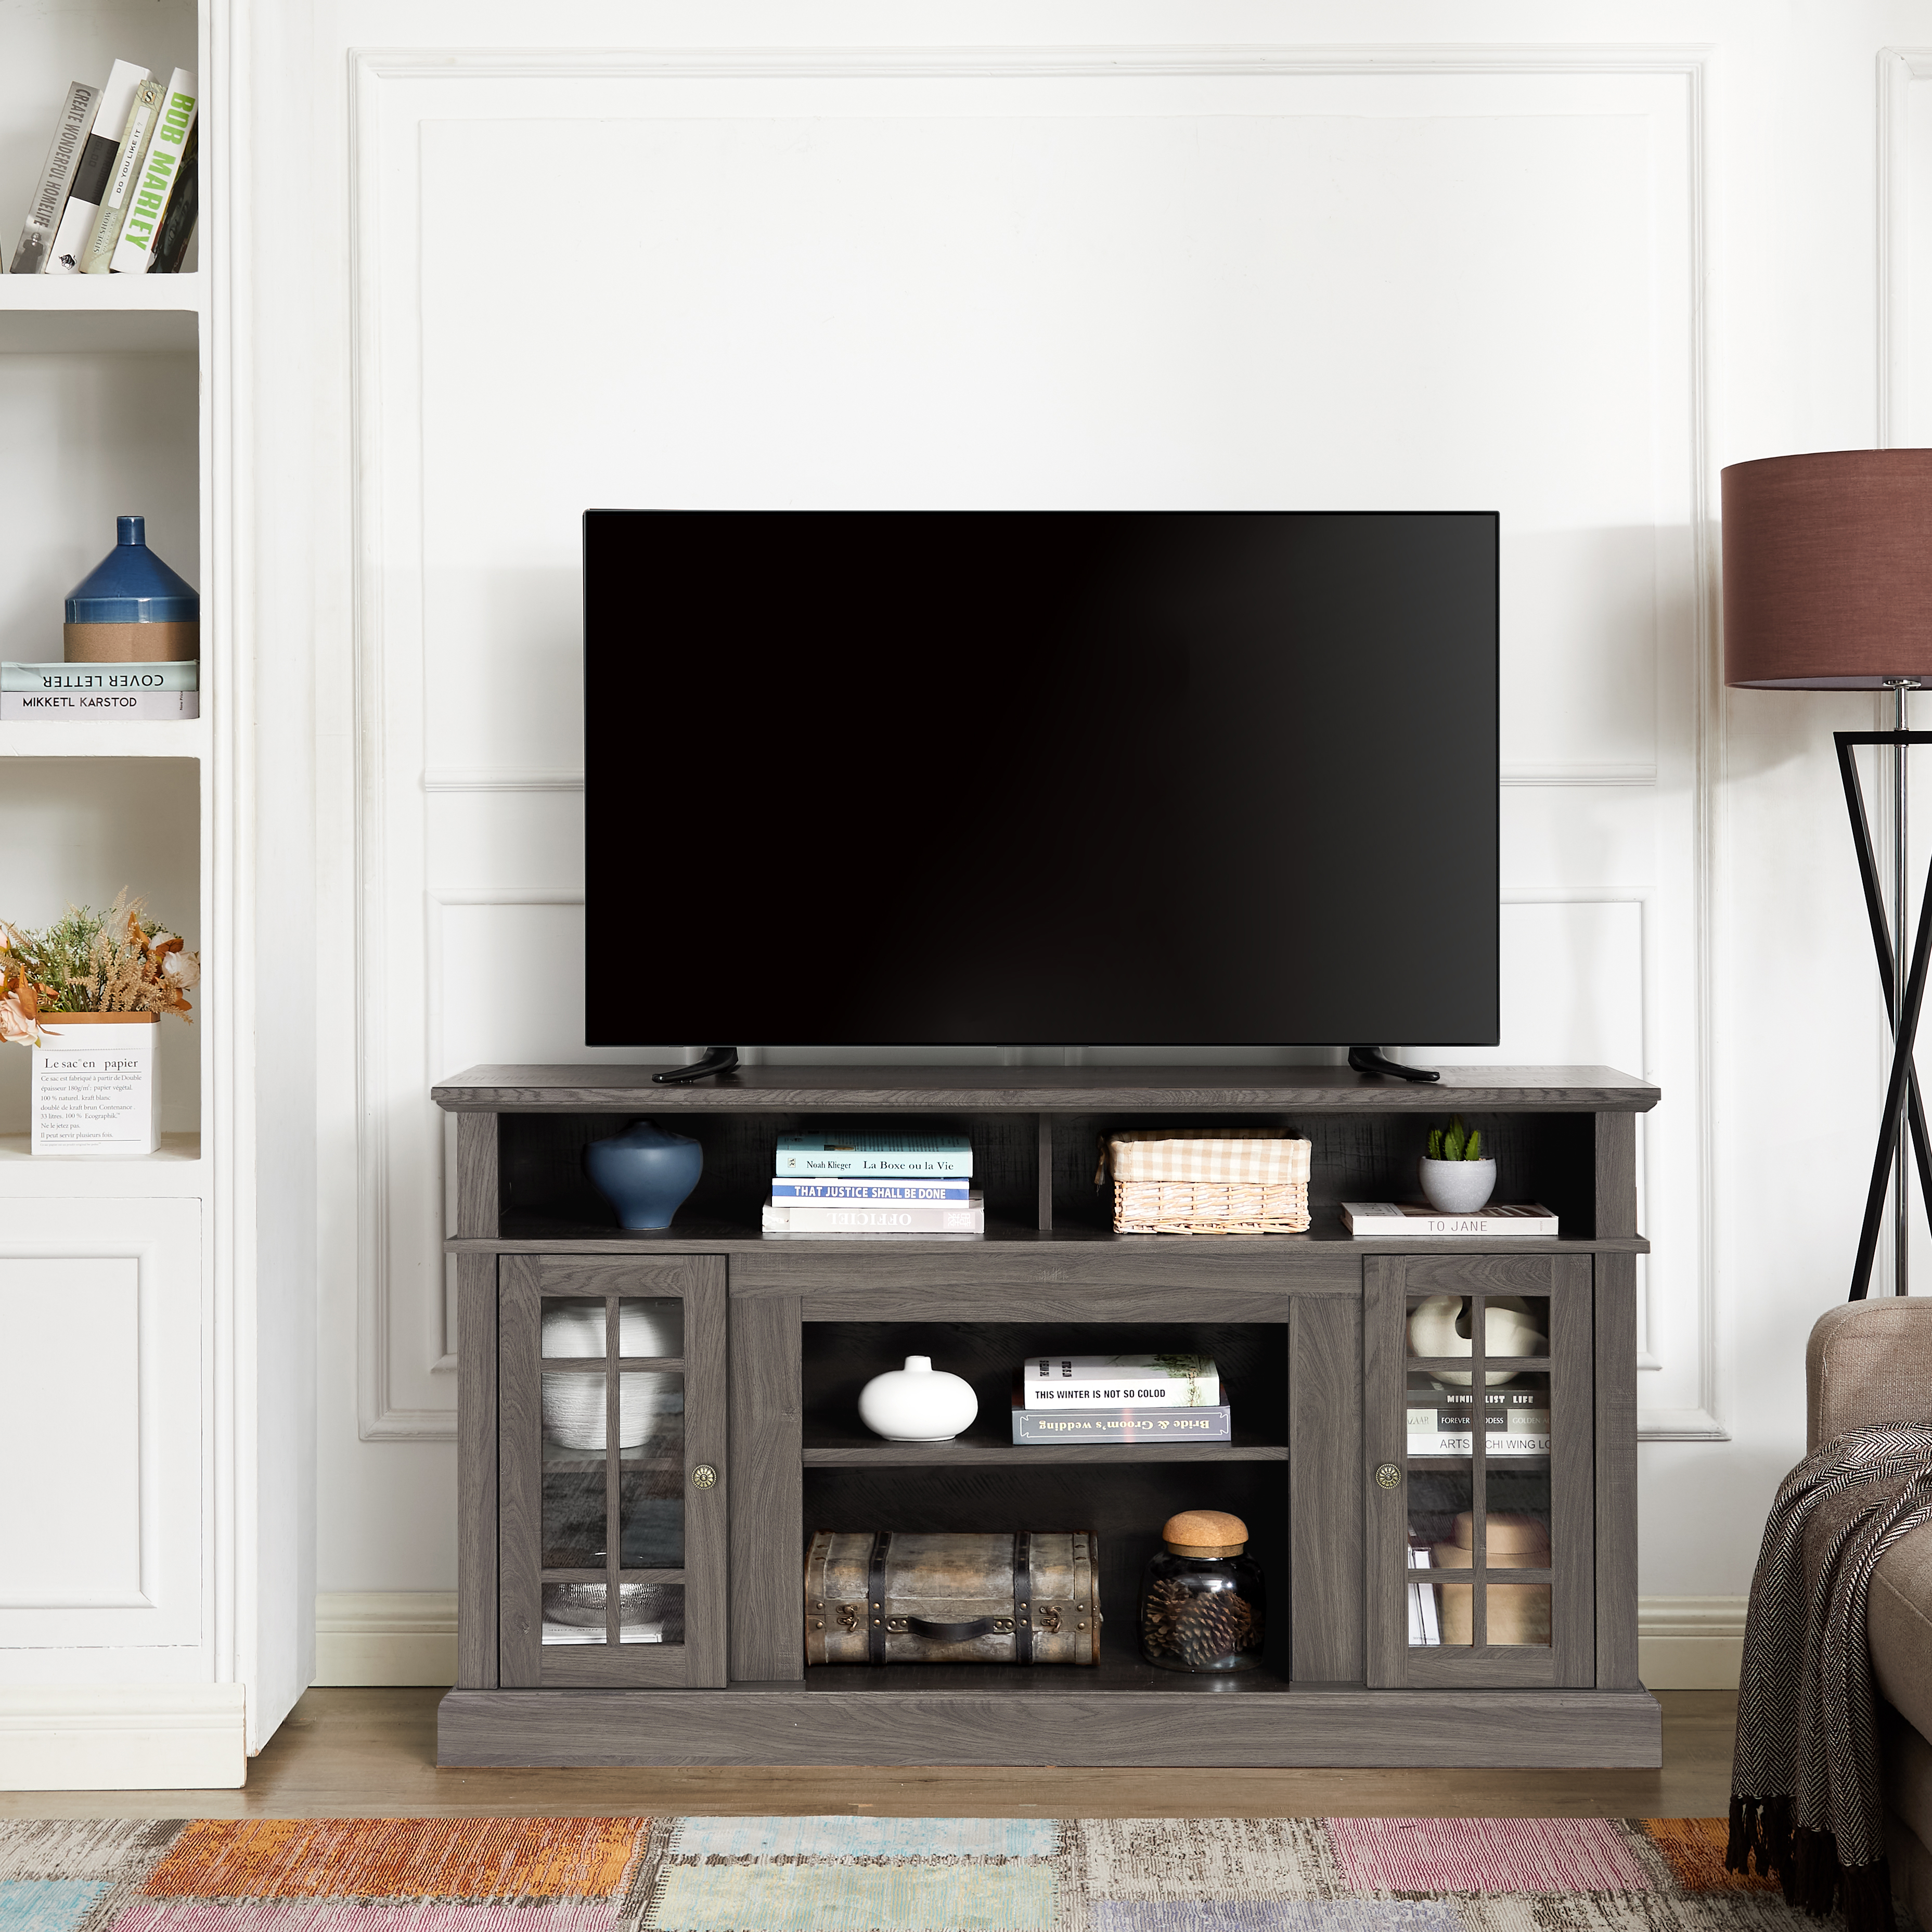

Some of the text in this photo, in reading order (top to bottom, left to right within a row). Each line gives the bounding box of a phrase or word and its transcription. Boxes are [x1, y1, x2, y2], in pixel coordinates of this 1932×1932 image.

[33, 89, 91, 228] CREATE WONDERFUL HOMELIFE
[116, 181, 124, 194] DO
[121, 161, 130, 177] YOU
[127, 139, 137, 159] LIKE
[134, 129, 141, 138] IT
[125, 92, 196, 251] BOB MARLEY
[94, 210, 111, 253] SIDESHOW
[43, 675, 164, 688] COVER LETTER
[23, 697, 137, 707] MIKKETL KARSTOD
[45, 1058, 59, 1068] Le
[105, 1058, 138, 1071] papier
[807, 1161, 826, 1169] Noah
[828, 1161, 852, 1170] Klieger
[864, 1161, 877, 1169] La
[880, 1161, 905, 1169] Boxe
[925, 1162, 934, 1170] la
[937, 1162, 954, 1170] Vie
[794, 1186, 946, 1199] THAT JUSTICE SHALL BE DONE
[827, 1212, 912, 1226] OFFICIEL
[1428, 1221, 1488, 1231] TO JANE
[1035, 1389, 1166, 1399] THIS WINTER IS NOT SO COLOD
[1039, 1420, 1092, 1431] wedding
[1157, 1420, 1170, 1429] &
[1174, 1420, 1210, 1429] Bride
[1440, 1439, 1470, 1449] ARTS
[1506, 1440, 1536, 1449] WING
